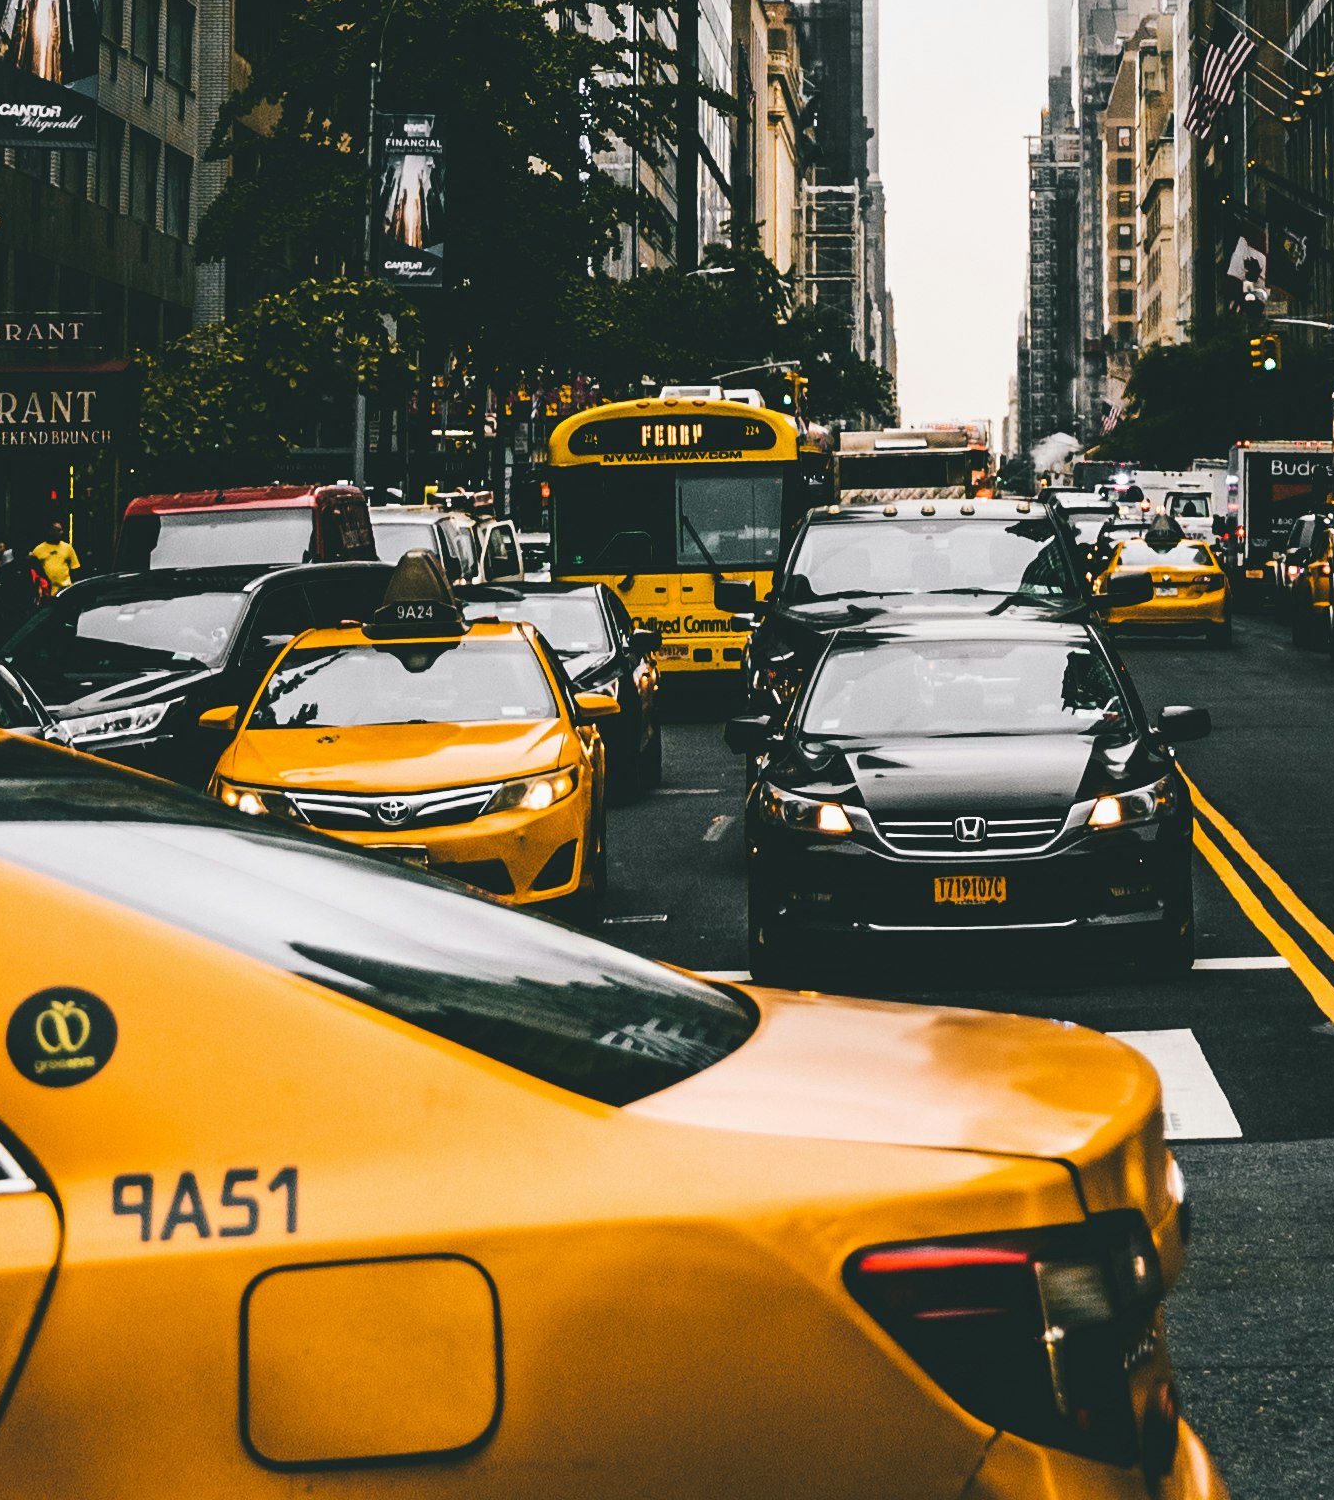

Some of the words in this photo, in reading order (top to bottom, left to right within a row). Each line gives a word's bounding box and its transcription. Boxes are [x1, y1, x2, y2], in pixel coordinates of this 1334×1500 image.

[15, 114, 84, 134] Fitzgerald
[385, 138, 443, 148] FINANCIAL
[51, 429, 112, 446] BRUNCH
[584, 433, 598, 444] 224
[745, 425, 760, 436] 224
[603, 453, 623, 462] NY
[625, 450, 743, 462] WATERWAY.COM
[397, 605, 434, 619] 9A24
[939, 877, 1003, 898] T719107C
[113, 1168, 298, 1242] 9A51
